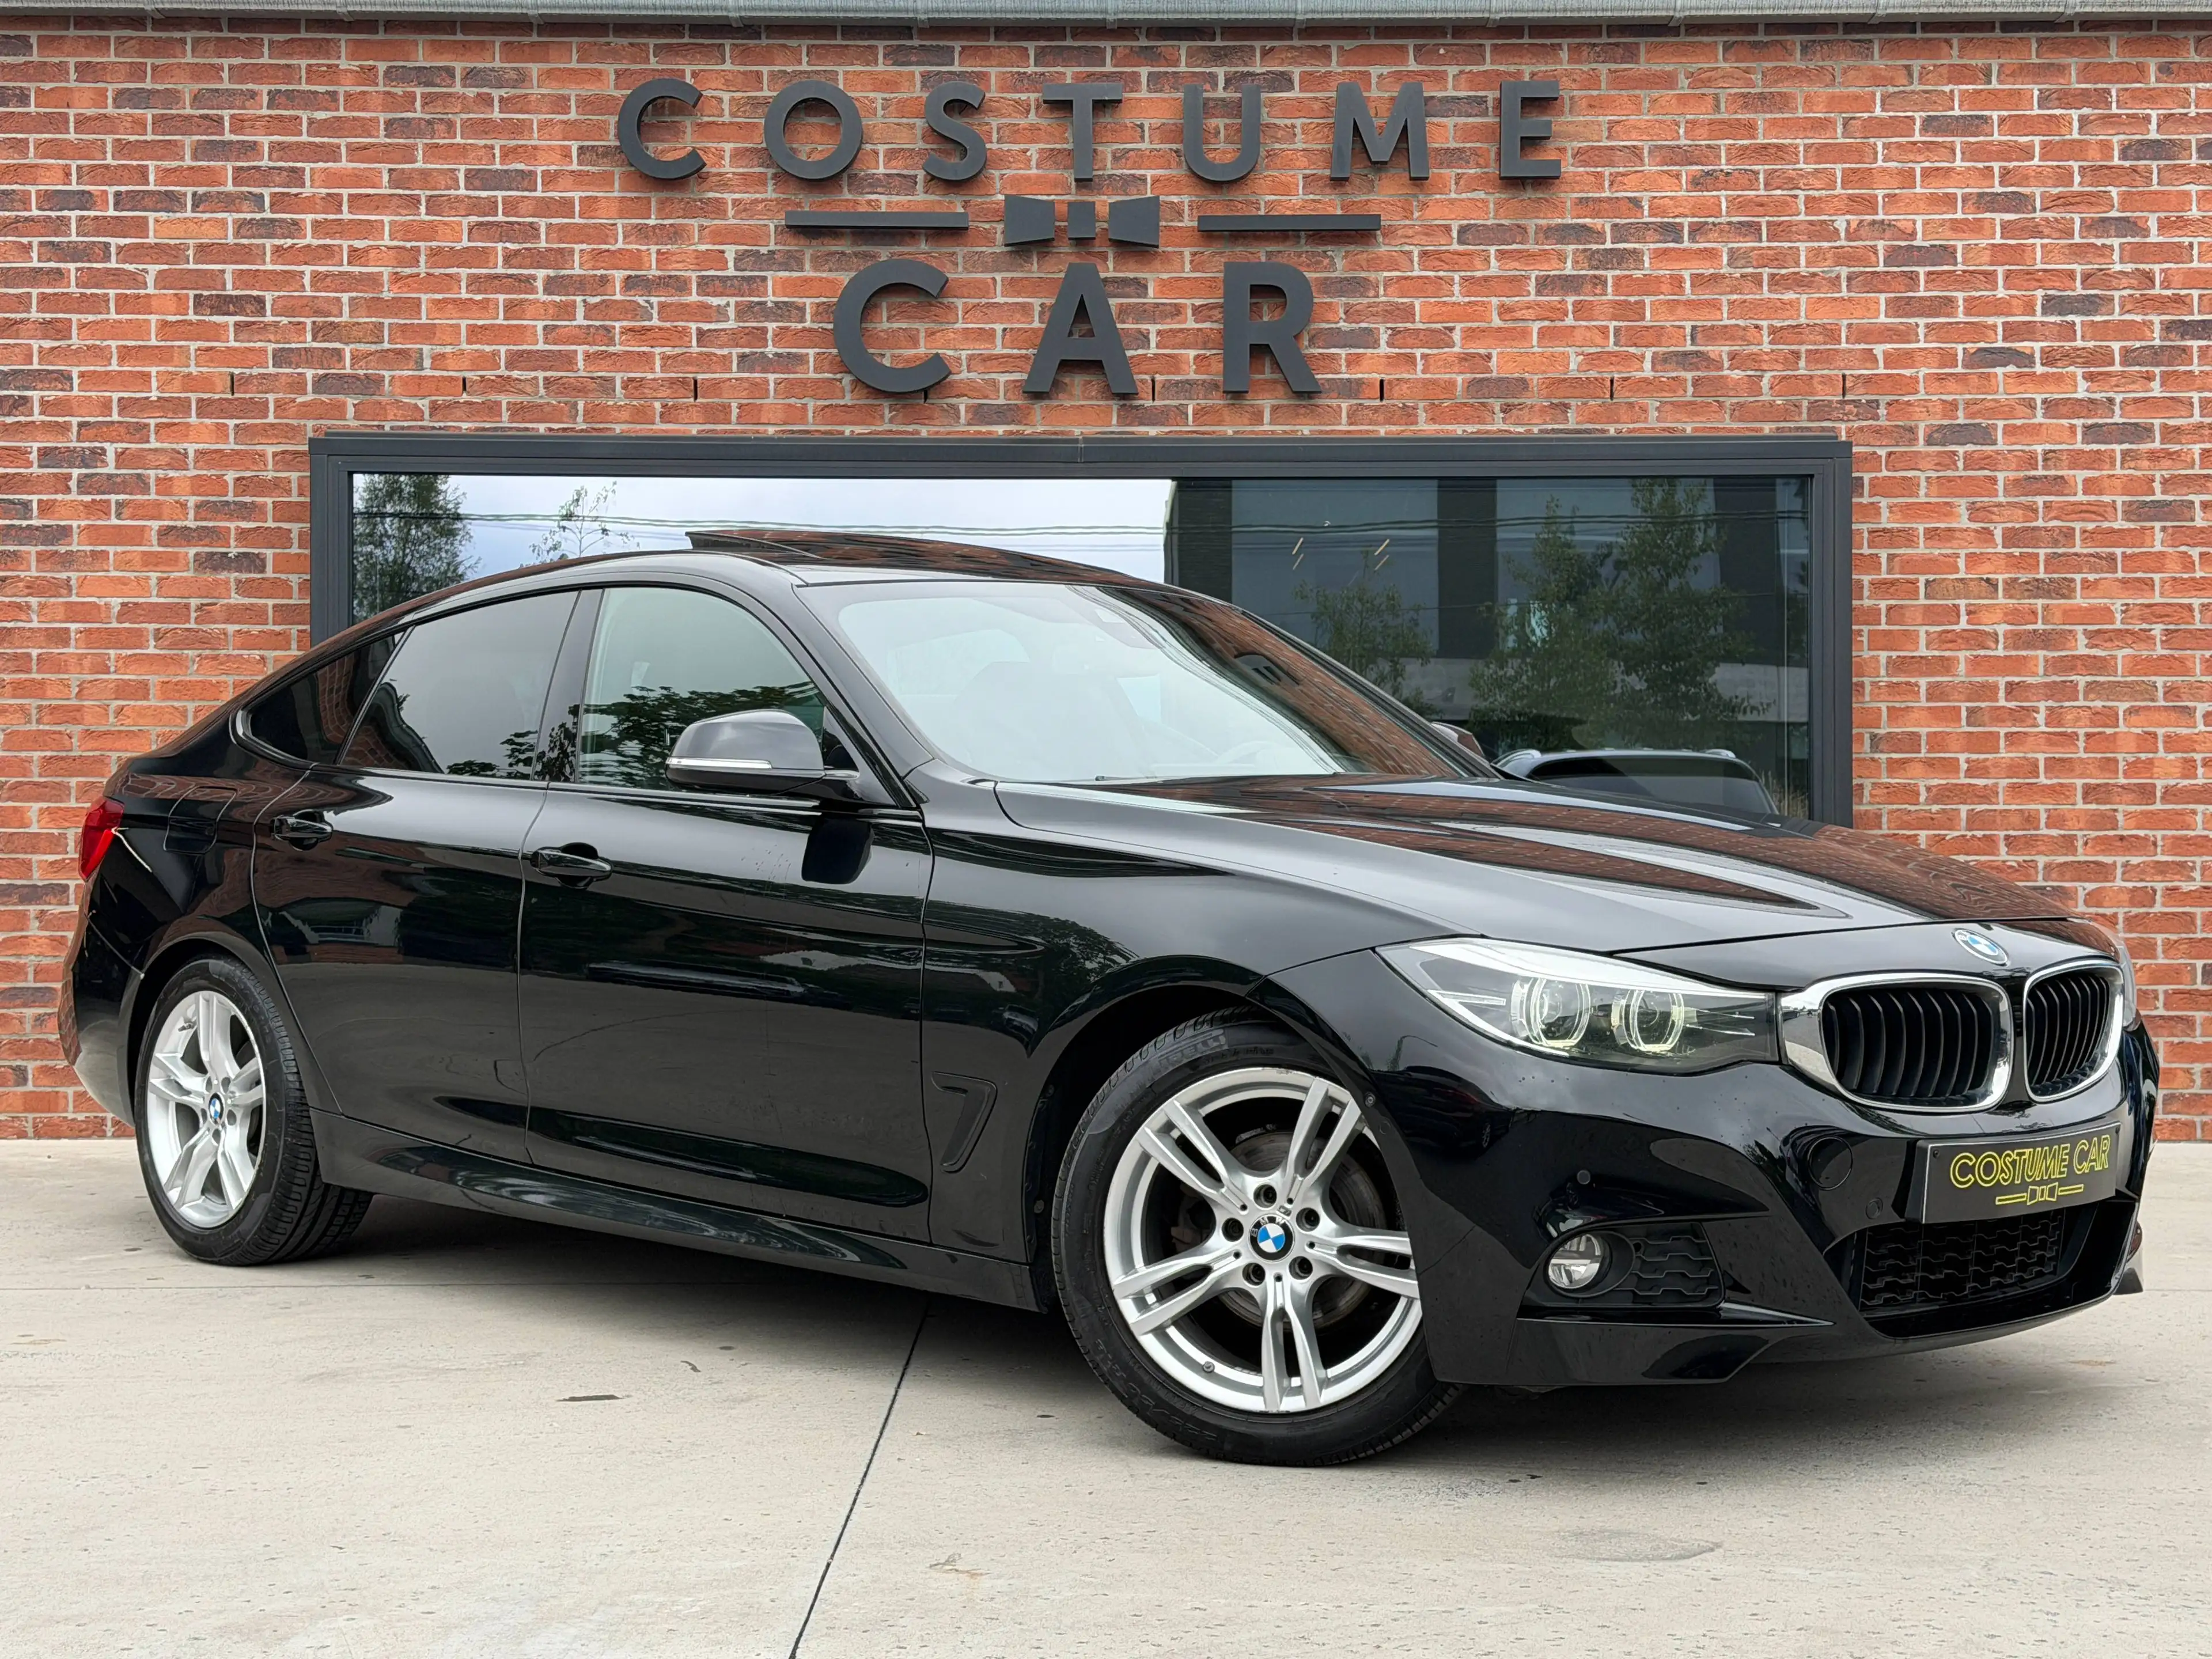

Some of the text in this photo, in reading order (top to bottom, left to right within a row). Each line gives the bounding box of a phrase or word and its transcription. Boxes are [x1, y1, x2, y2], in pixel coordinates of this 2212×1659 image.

[617, 78, 1562, 181] COSTUME
[834, 260, 1321, 395] CAR
[1950, 1134, 2111, 1188] COSTUME CAR
[1251, 1216, 1286, 1237] BMW
